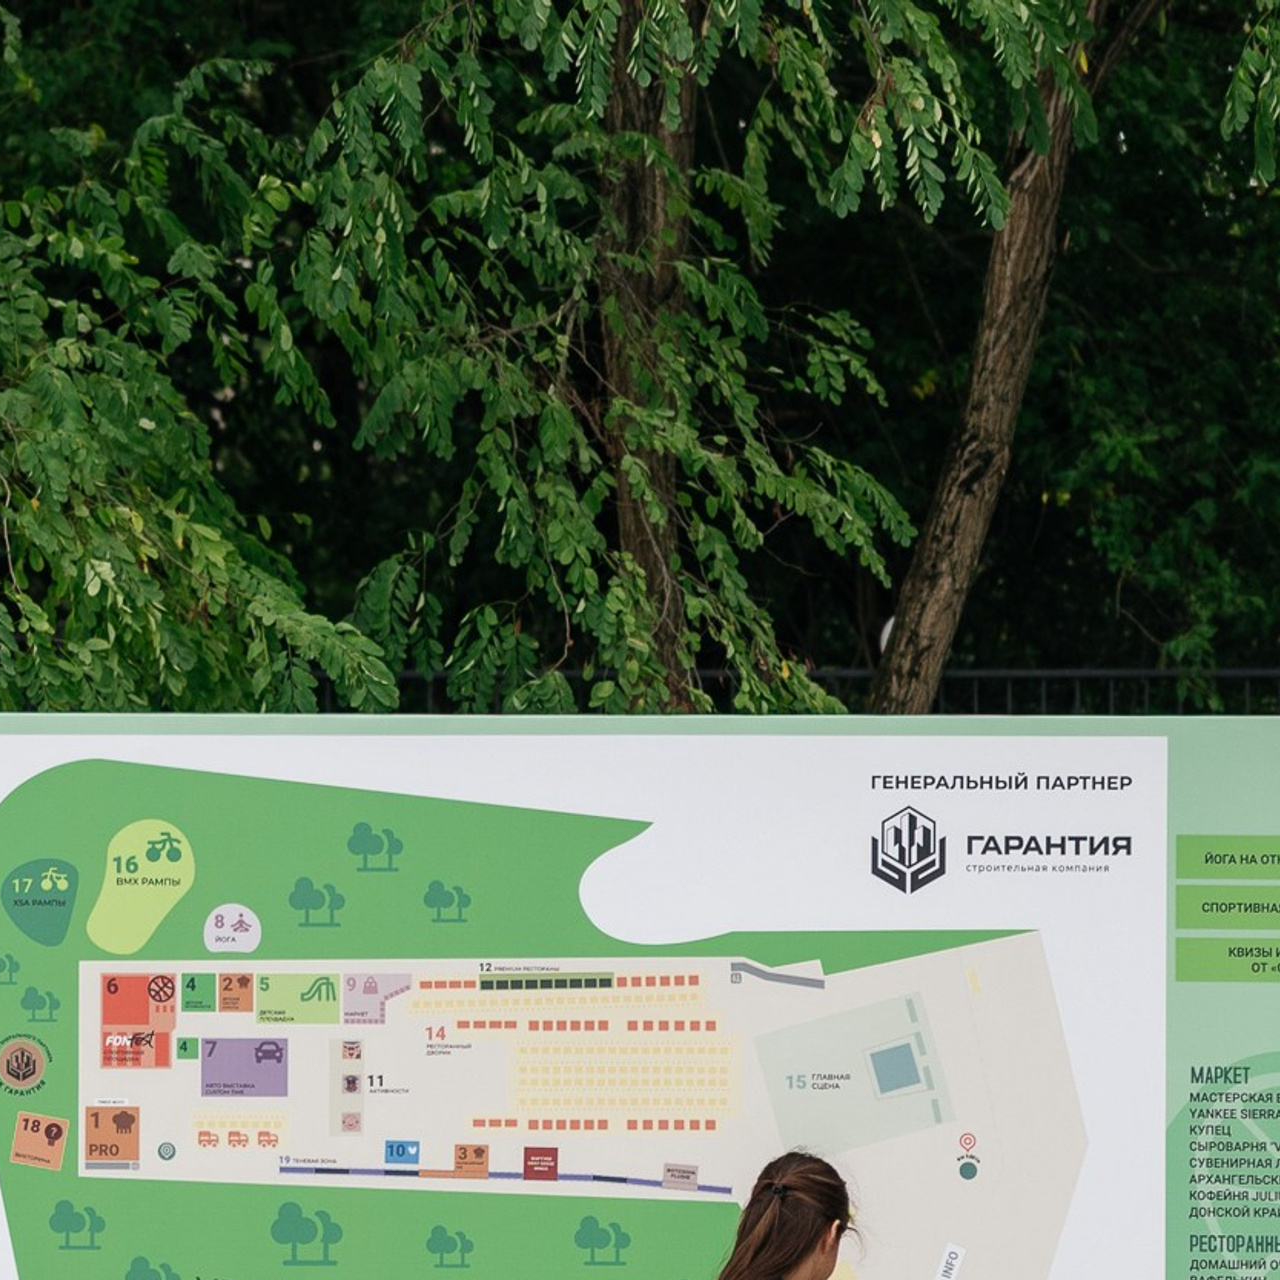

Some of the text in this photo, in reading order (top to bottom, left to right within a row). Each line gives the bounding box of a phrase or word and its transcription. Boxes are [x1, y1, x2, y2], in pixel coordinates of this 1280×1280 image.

[872, 772, 1132, 790] ГЕНЕРАЛЬНЫЙ ПАРТНЕР
[967, 836, 1131, 856] ГАРАНТИЯ
[113, 855, 139, 874] 16
[966, 865, 1109, 873] строительная компания
[11, 878, 32, 893] 17
[141, 877, 180, 887] РАМПЫ
[214, 914, 225, 929] 8
[1228, 947, 1272, 958] КВИЗЫ
[480, 963, 492, 972] 12
[106, 977, 119, 994] 6
[186, 977, 196, 991] 4
[222, 975, 233, 991] 2
[259, 976, 269, 992] 5
[425, 1026, 446, 1041] 14
[205, 1041, 217, 1057] 7
[367, 1075, 383, 1087] 11
[1191, 1066, 1250, 1084] МАРКЕТ
[786, 1075, 807, 1090] 15
[811, 1082, 840, 1090] СЦЕНА
[1189, 1108, 1237, 1119] YANKEE
[22, 1118, 41, 1133] 18
[1190, 1125, 1232, 1137] КУПЕЦ
[89, 1144, 119, 1157] PRO
[387, 1144, 405, 1158] 10
[1189, 1141, 1267, 1152] СЫРОВАРНЯ
[1189, 1189, 1249, 1201] КОФЕЙНЯ
[1189, 1205, 1250, 1219] ДОНСКОЙ
[942, 1250, 959, 1279] INFO
[1190, 1258, 1266, 1272] ДОМАШНИЙ
